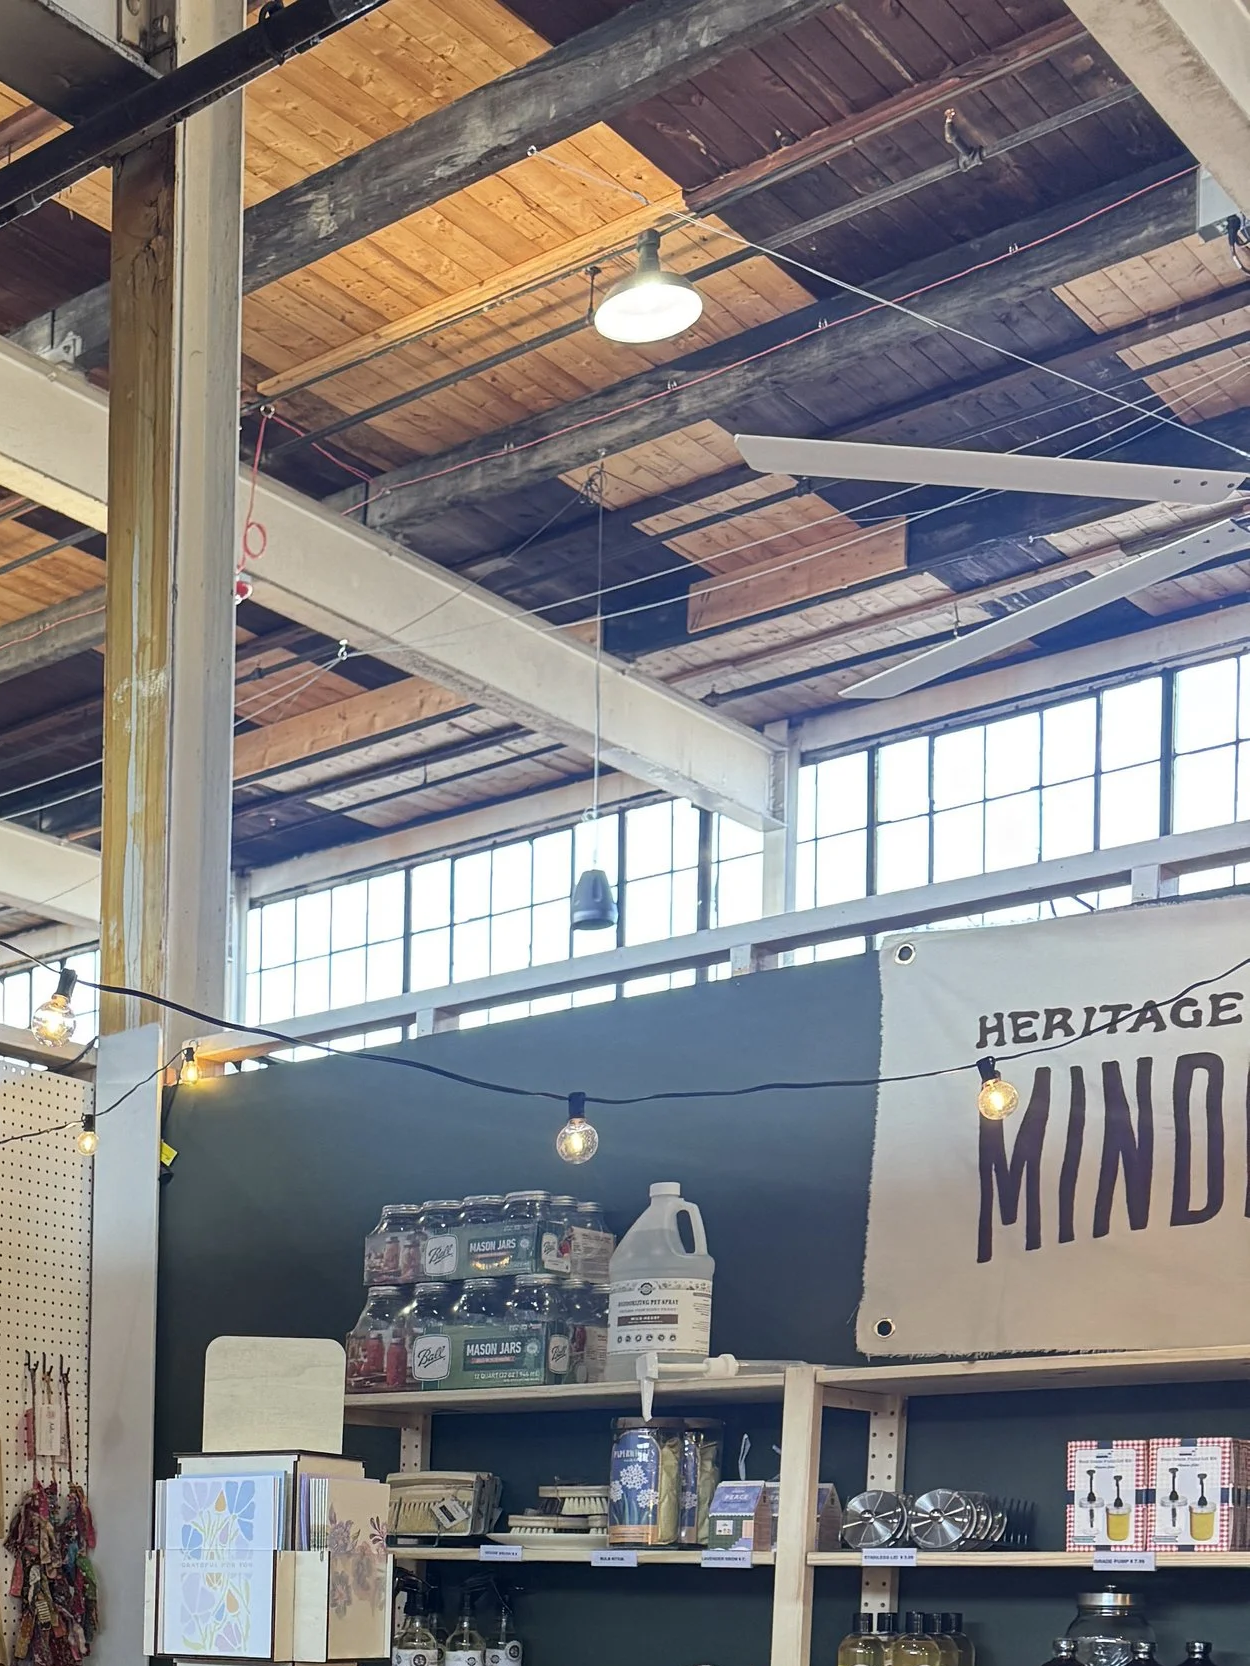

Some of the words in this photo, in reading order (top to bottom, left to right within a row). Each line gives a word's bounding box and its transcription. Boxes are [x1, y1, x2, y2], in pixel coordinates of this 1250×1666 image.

[975, 991, 1245, 1049] HERITAGE
[976, 1051, 1250, 1264] MIND
[428, 1243, 454, 1265] Ball
[469, 1240, 496, 1253] MASON
[497, 1238, 517, 1250] JARS
[417, 1345, 447, 1368] Ball
[466, 1342, 498, 1357] MASON
[499, 1341, 523, 1354] JARS
